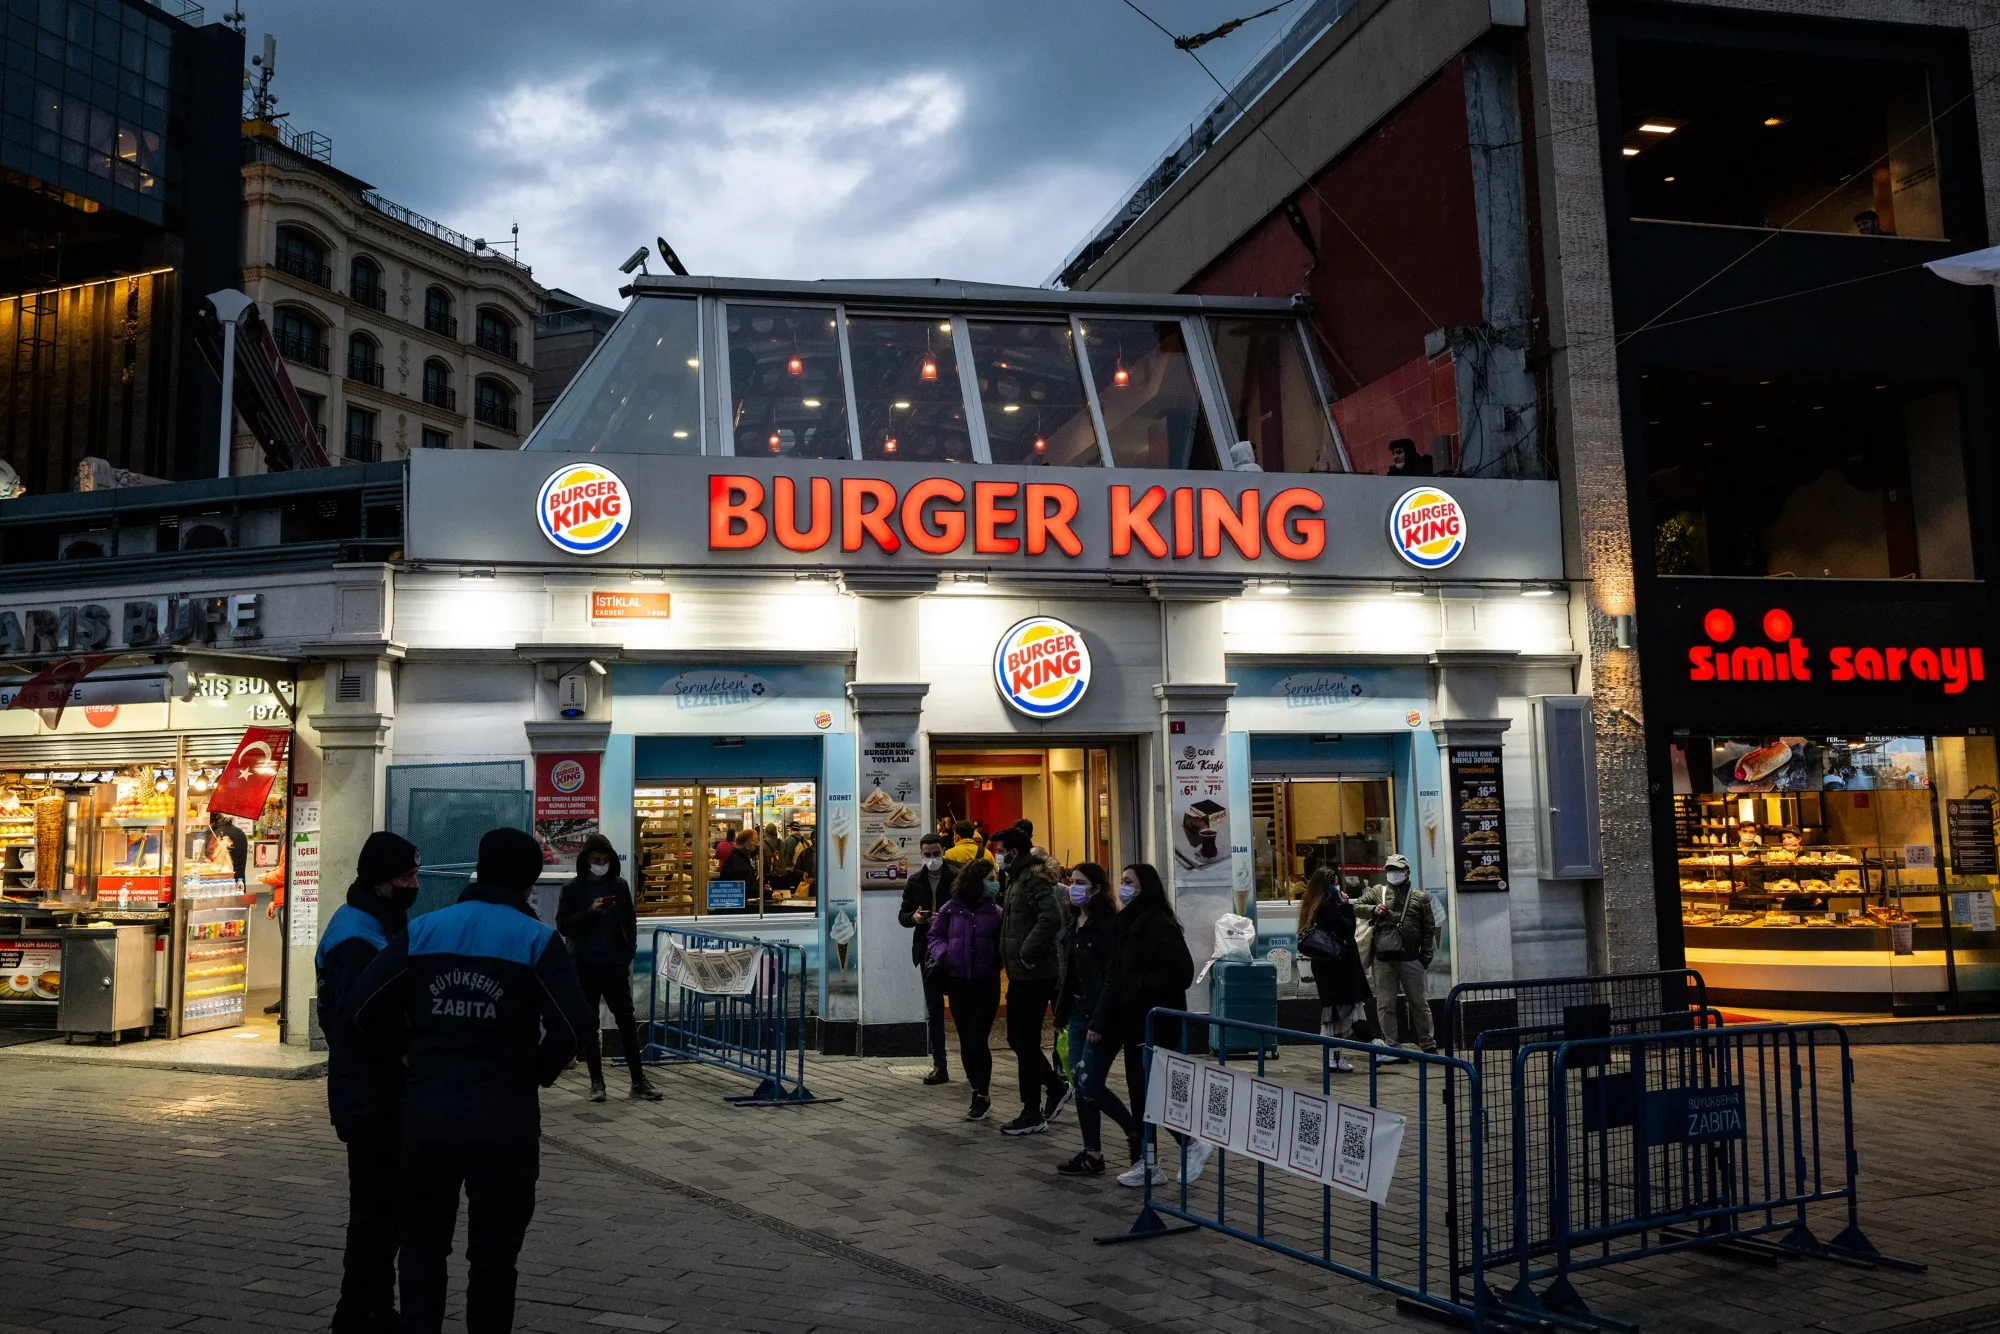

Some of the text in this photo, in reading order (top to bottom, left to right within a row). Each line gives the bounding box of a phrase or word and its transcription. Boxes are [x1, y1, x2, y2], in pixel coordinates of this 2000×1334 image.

[550, 481, 618, 511] BURGER
[554, 495, 621, 533] KING
[708, 474, 1325, 561] BURGER KING
[1402, 503, 1456, 529] BURGER
[1405, 516, 1460, 549] KING
[596, 595, 642, 607] İSTİKLAL
[1008, 634, 1076, 672] BURGER
[1689, 608, 1985, 695] simit sarayı
[1013, 651, 1080, 695] KING
[674, 677, 747, 695] Serinleten
[1284, 678, 1347, 696] Serinleten
[676, 688, 751, 709] LEZZETLER
[1286, 690, 1351, 709] LEZZETLER
[247, 705, 285, 720] 1974
[816, 717, 832, 726] KING
[1408, 715, 1421, 724] KING
[875, 742, 906, 750] MEŞHUR
[555, 767, 580, 779] BURGER
[1175, 760, 1224, 773] Tatlı Keyfi
[557, 772, 581, 786] KING
[298, 846, 318, 857] İÇERİ
[429, 968, 504, 1002] BÜYÜKŞEHİR
[431, 998, 497, 1018] ZABITA
[1688, 1109, 1742, 1137] ZABITA
